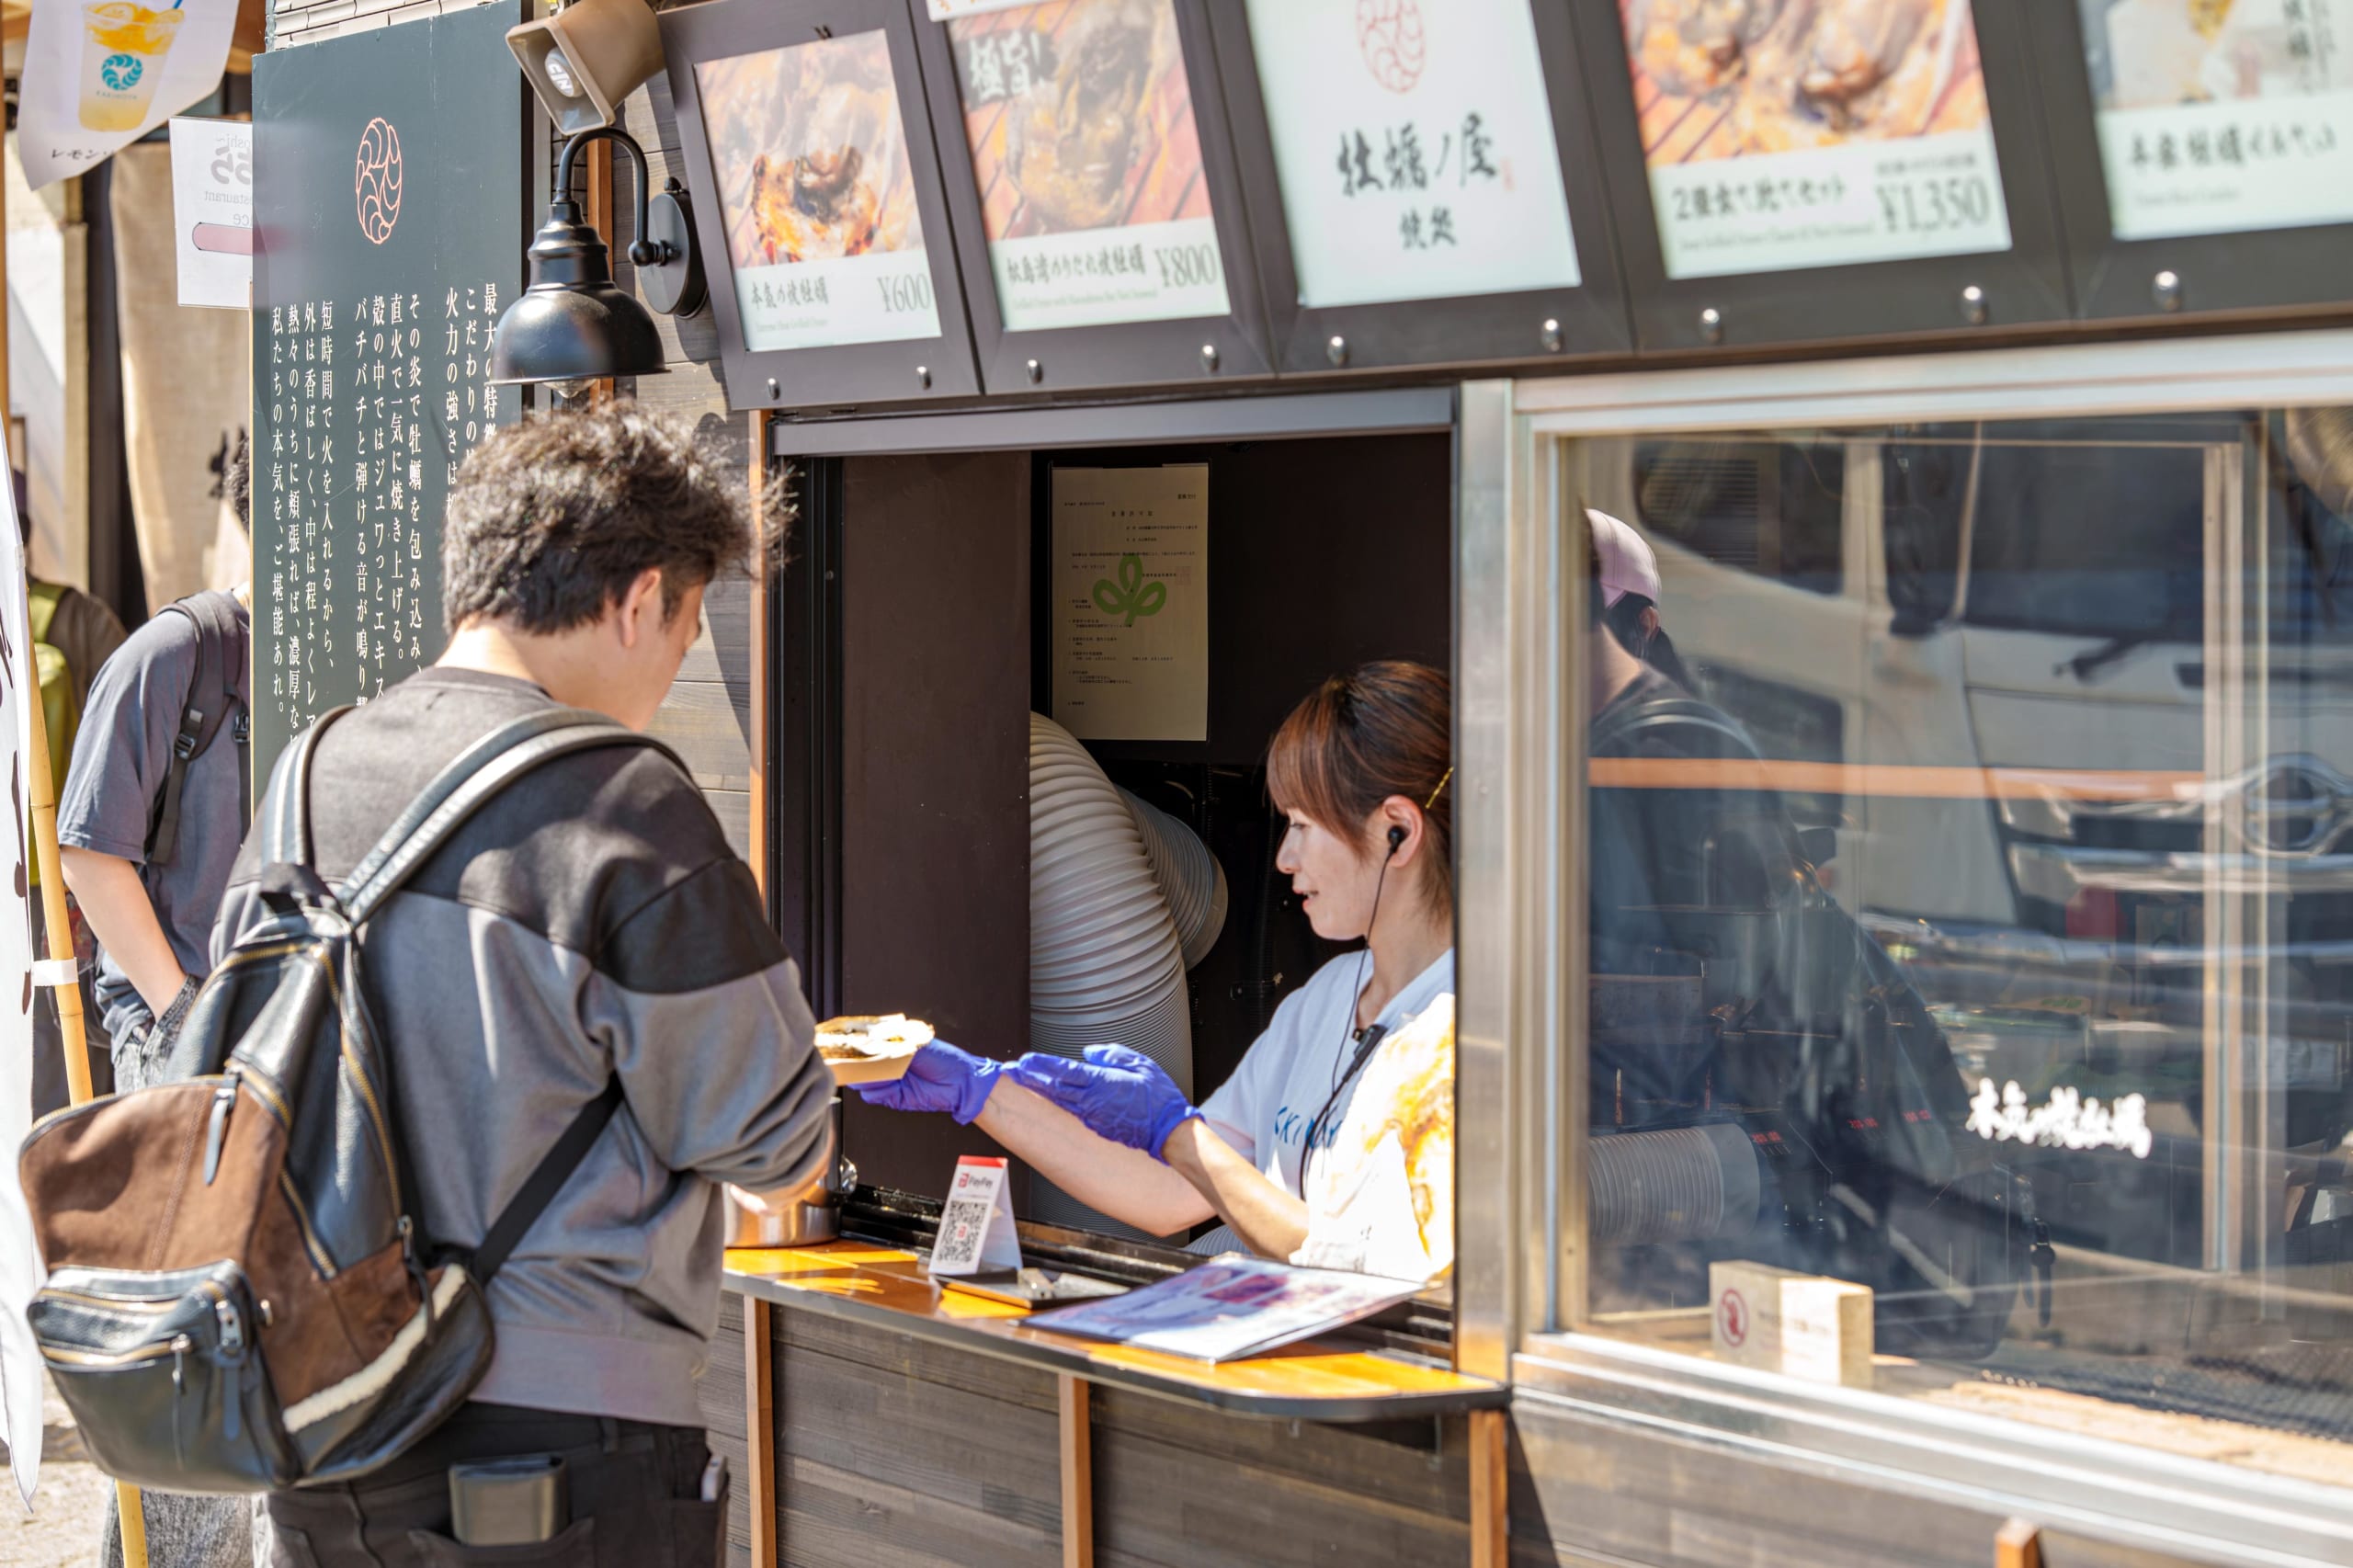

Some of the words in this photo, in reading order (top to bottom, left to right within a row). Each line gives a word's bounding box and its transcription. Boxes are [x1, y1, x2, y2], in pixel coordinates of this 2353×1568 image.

[1154, 243, 1218, 289] ¥800
[1336, 112, 1496, 197] 牡蠣ノ屋
[465, 288, 478, 459] こだわりの
[877, 272, 932, 313] ¥600
[272, 307, 284, 712] 私たちの本気を、ご堪能あれ。
[321, 300, 334, 668] 短時間で火を入れるから、
[390, 292, 404, 660] 直火で一気に焼き上げる。
[408, 293, 422, 674] その炎で牡蠣を包み込み、
